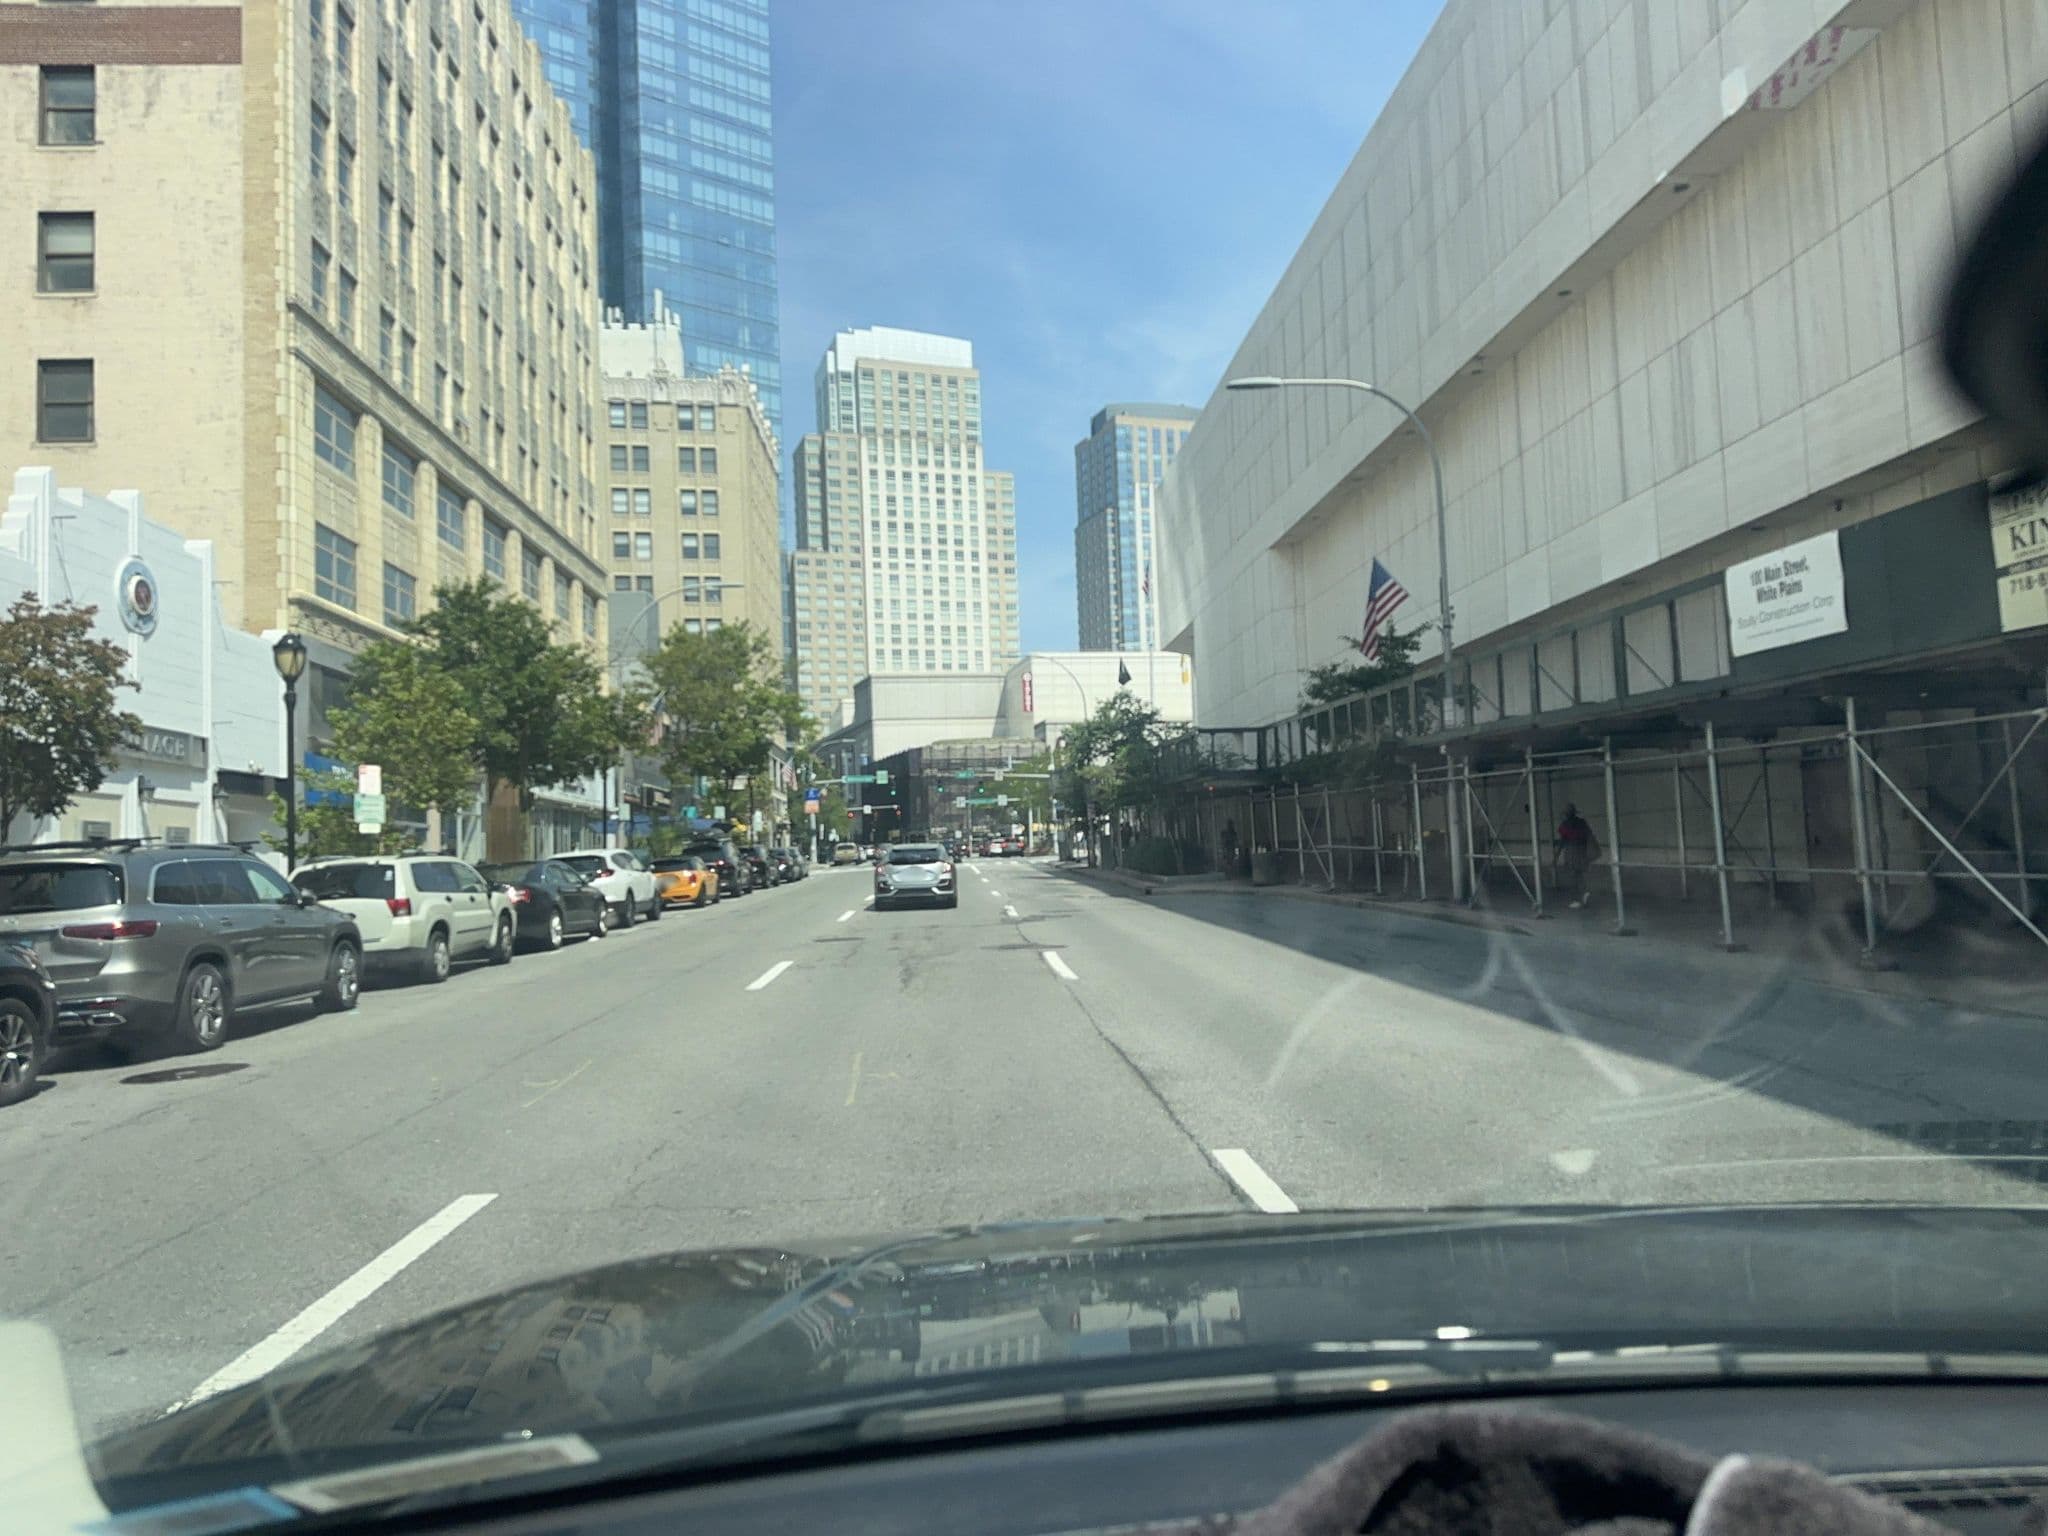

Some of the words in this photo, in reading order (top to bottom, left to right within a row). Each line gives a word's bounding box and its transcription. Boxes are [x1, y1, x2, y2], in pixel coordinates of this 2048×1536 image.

[1764, 564, 1781, 583] Main
[1756, 584, 1777, 604] White
[1779, 579, 1803, 598] Plains
[1759, 602, 1810, 624] Construction
